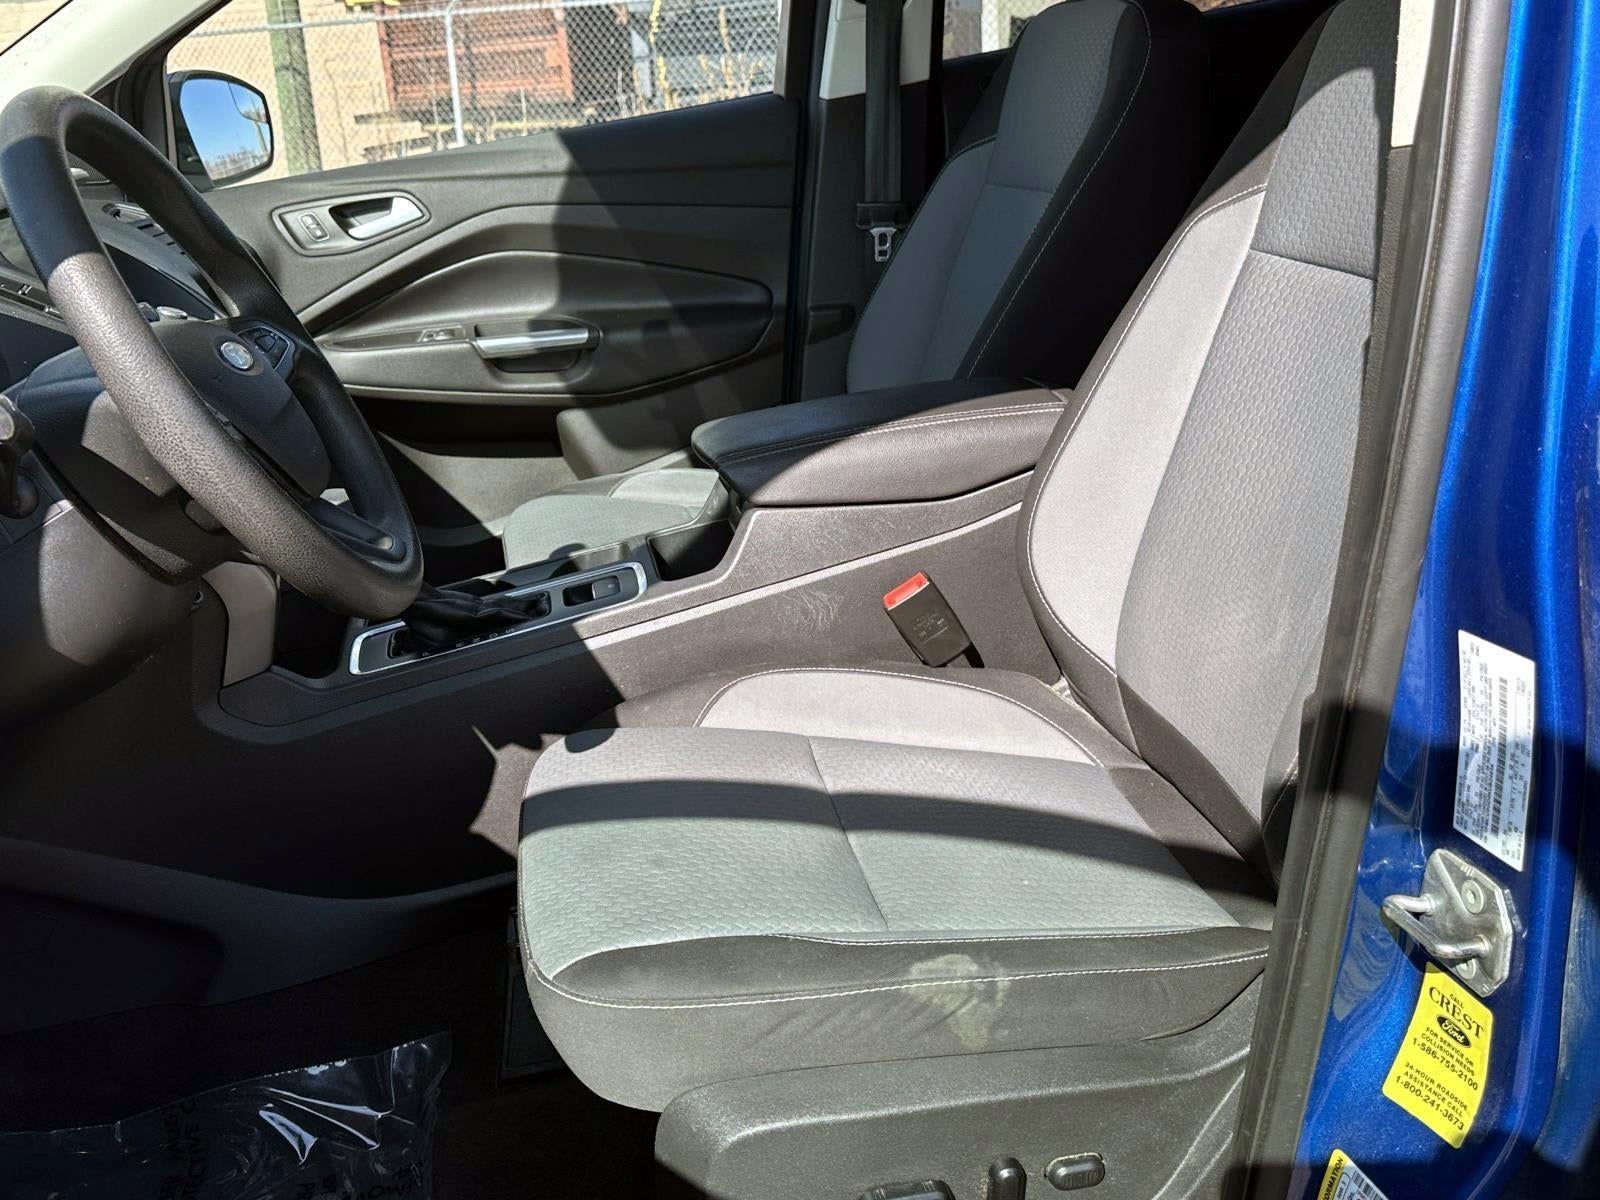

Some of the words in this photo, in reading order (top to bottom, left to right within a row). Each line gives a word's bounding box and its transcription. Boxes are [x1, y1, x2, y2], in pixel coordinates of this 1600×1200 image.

[1429, 986, 1484, 1039] CREST
[1450, 993, 1464, 1009] CALL
[1425, 1027, 1438, 1040] FOR
[1439, 1036, 1464, 1060] SERVICE
[1464, 1056, 1474, 1067] OR
[1440, 1018, 1466, 1045] Ford
[1412, 1037, 1479, 1091] 1-586-755-2100
[1421, 1033, 1455, 1061] COLLISION
[1455, 1054, 1475, 1077] NEEDS
[1396, 1075, 1465, 1131] 1-800-241-3673
[1403, 1071, 1446, 1104] ASSISTANCE
[1446, 1098, 1464, 1118] CALL
[1405, 1061, 1436, 1085] 24-HOUR
[1436, 1080, 1469, 1111] ROADSIDE
[1322, 1158, 1343, 1200] ORMATION
